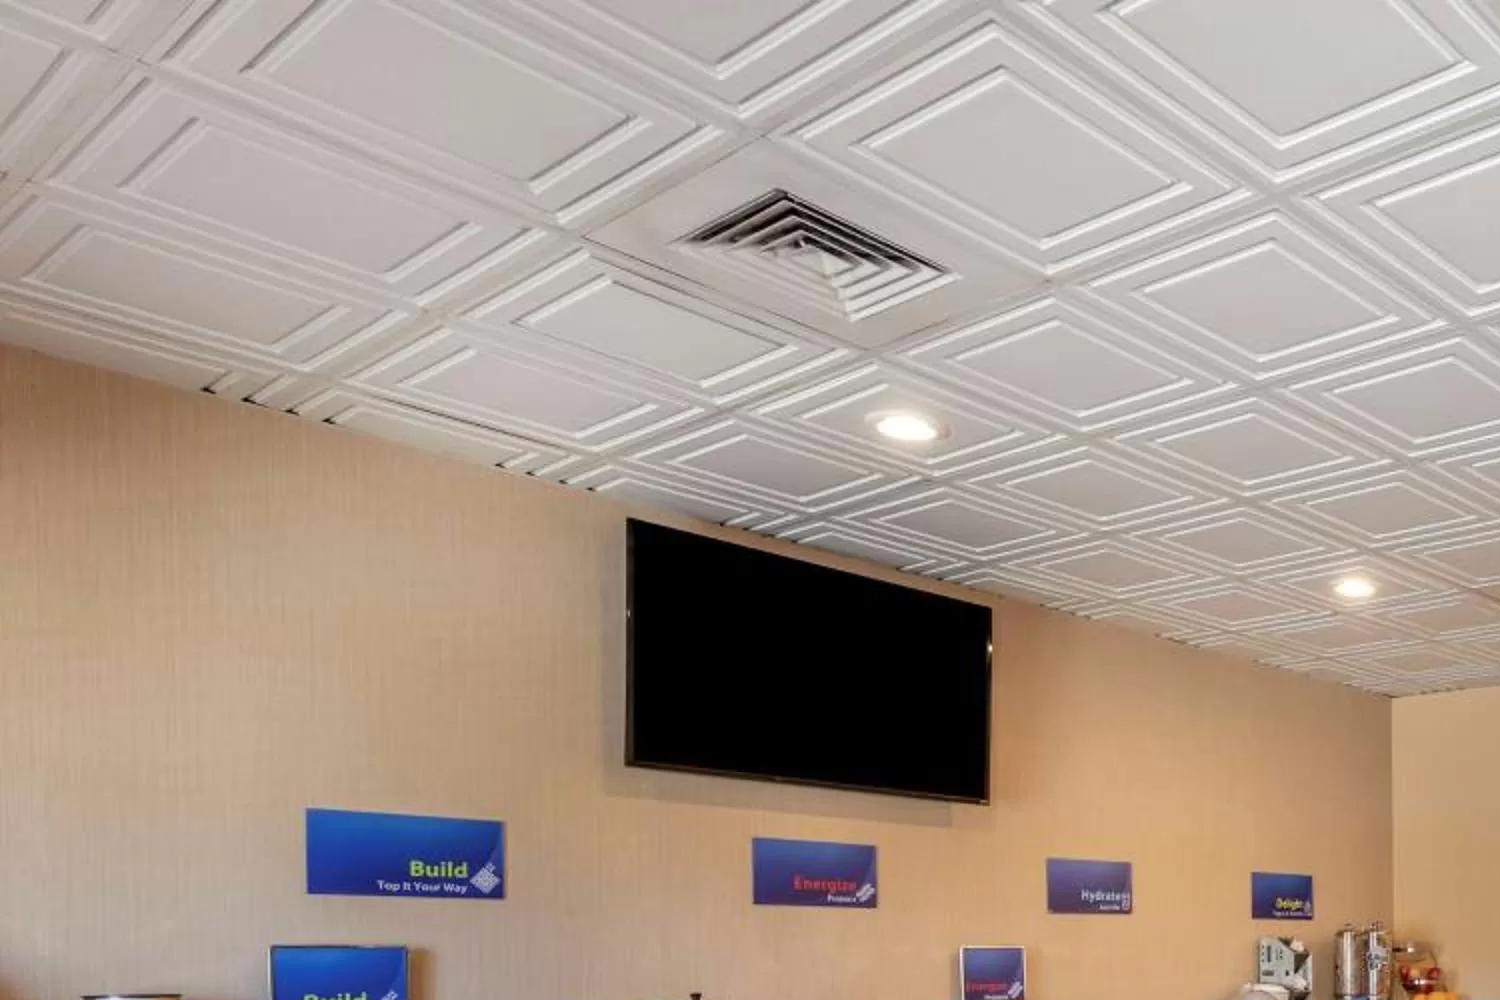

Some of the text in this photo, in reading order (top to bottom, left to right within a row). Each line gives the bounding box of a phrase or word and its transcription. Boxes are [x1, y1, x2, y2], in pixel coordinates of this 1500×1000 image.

[409, 860, 468, 878] Build
[377, 880, 401, 893] Top
[414, 882, 440, 892] Your
[443, 883, 468, 894] Way
[793, 873, 858, 894] Energize
[1081, 889, 1121, 903] Hydrate
